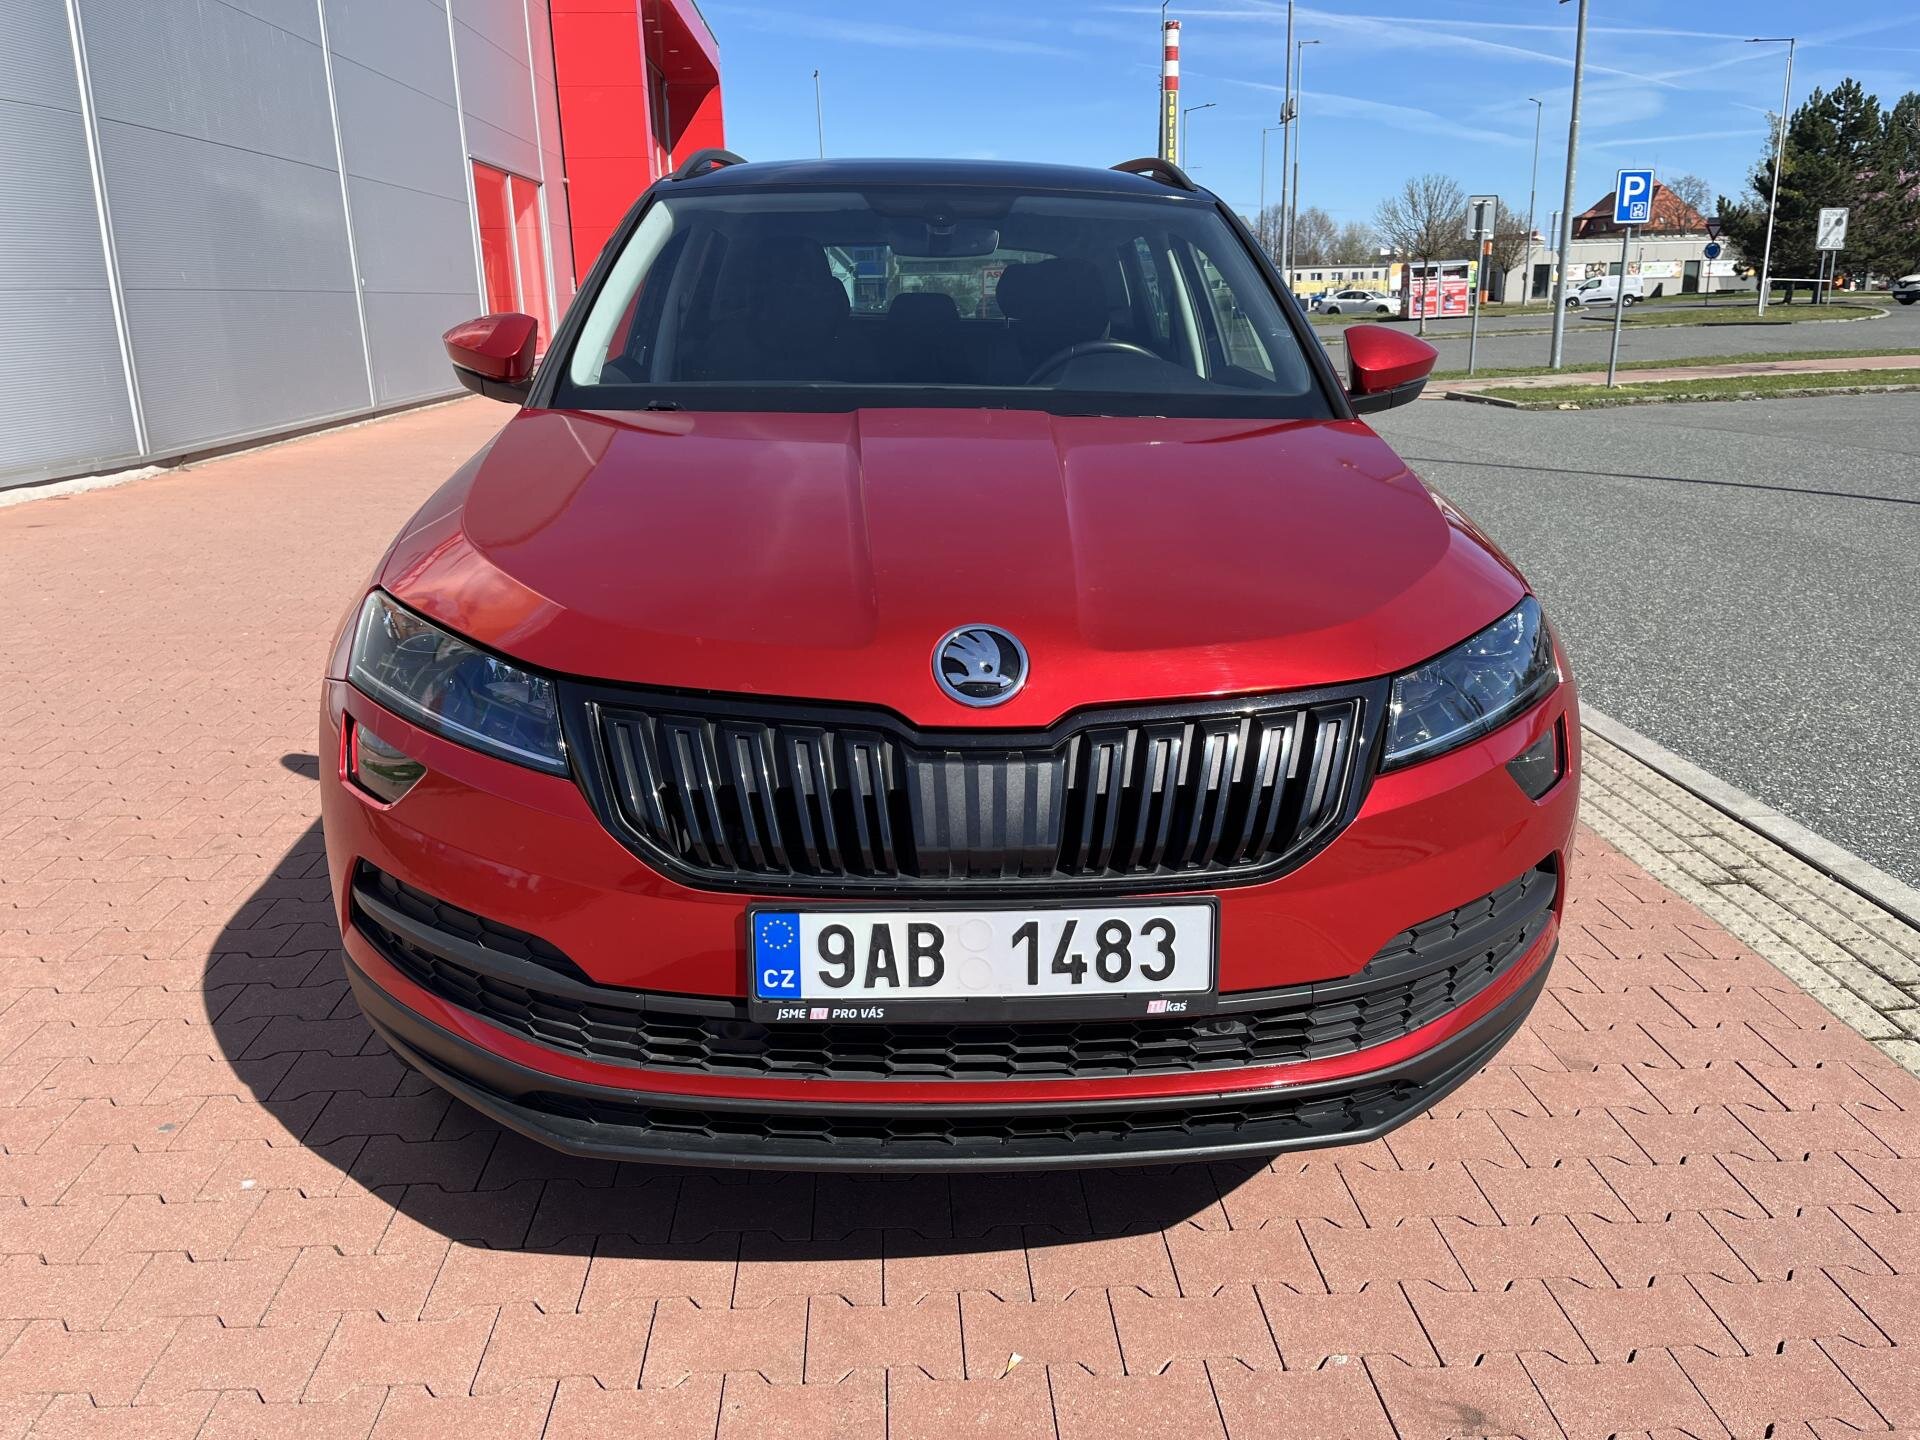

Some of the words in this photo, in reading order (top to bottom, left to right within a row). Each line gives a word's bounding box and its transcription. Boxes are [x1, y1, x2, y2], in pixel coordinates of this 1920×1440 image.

[1623, 176, 1646, 207] P
[817, 922, 945, 989] 9AB
[1011, 917, 1176, 985] 1483
[763, 970, 795, 988] CZ
[776, 1008, 806, 1020] JSME
[832, 1008, 857, 1018] PRO
[860, 1006, 884, 1018] VÁS
